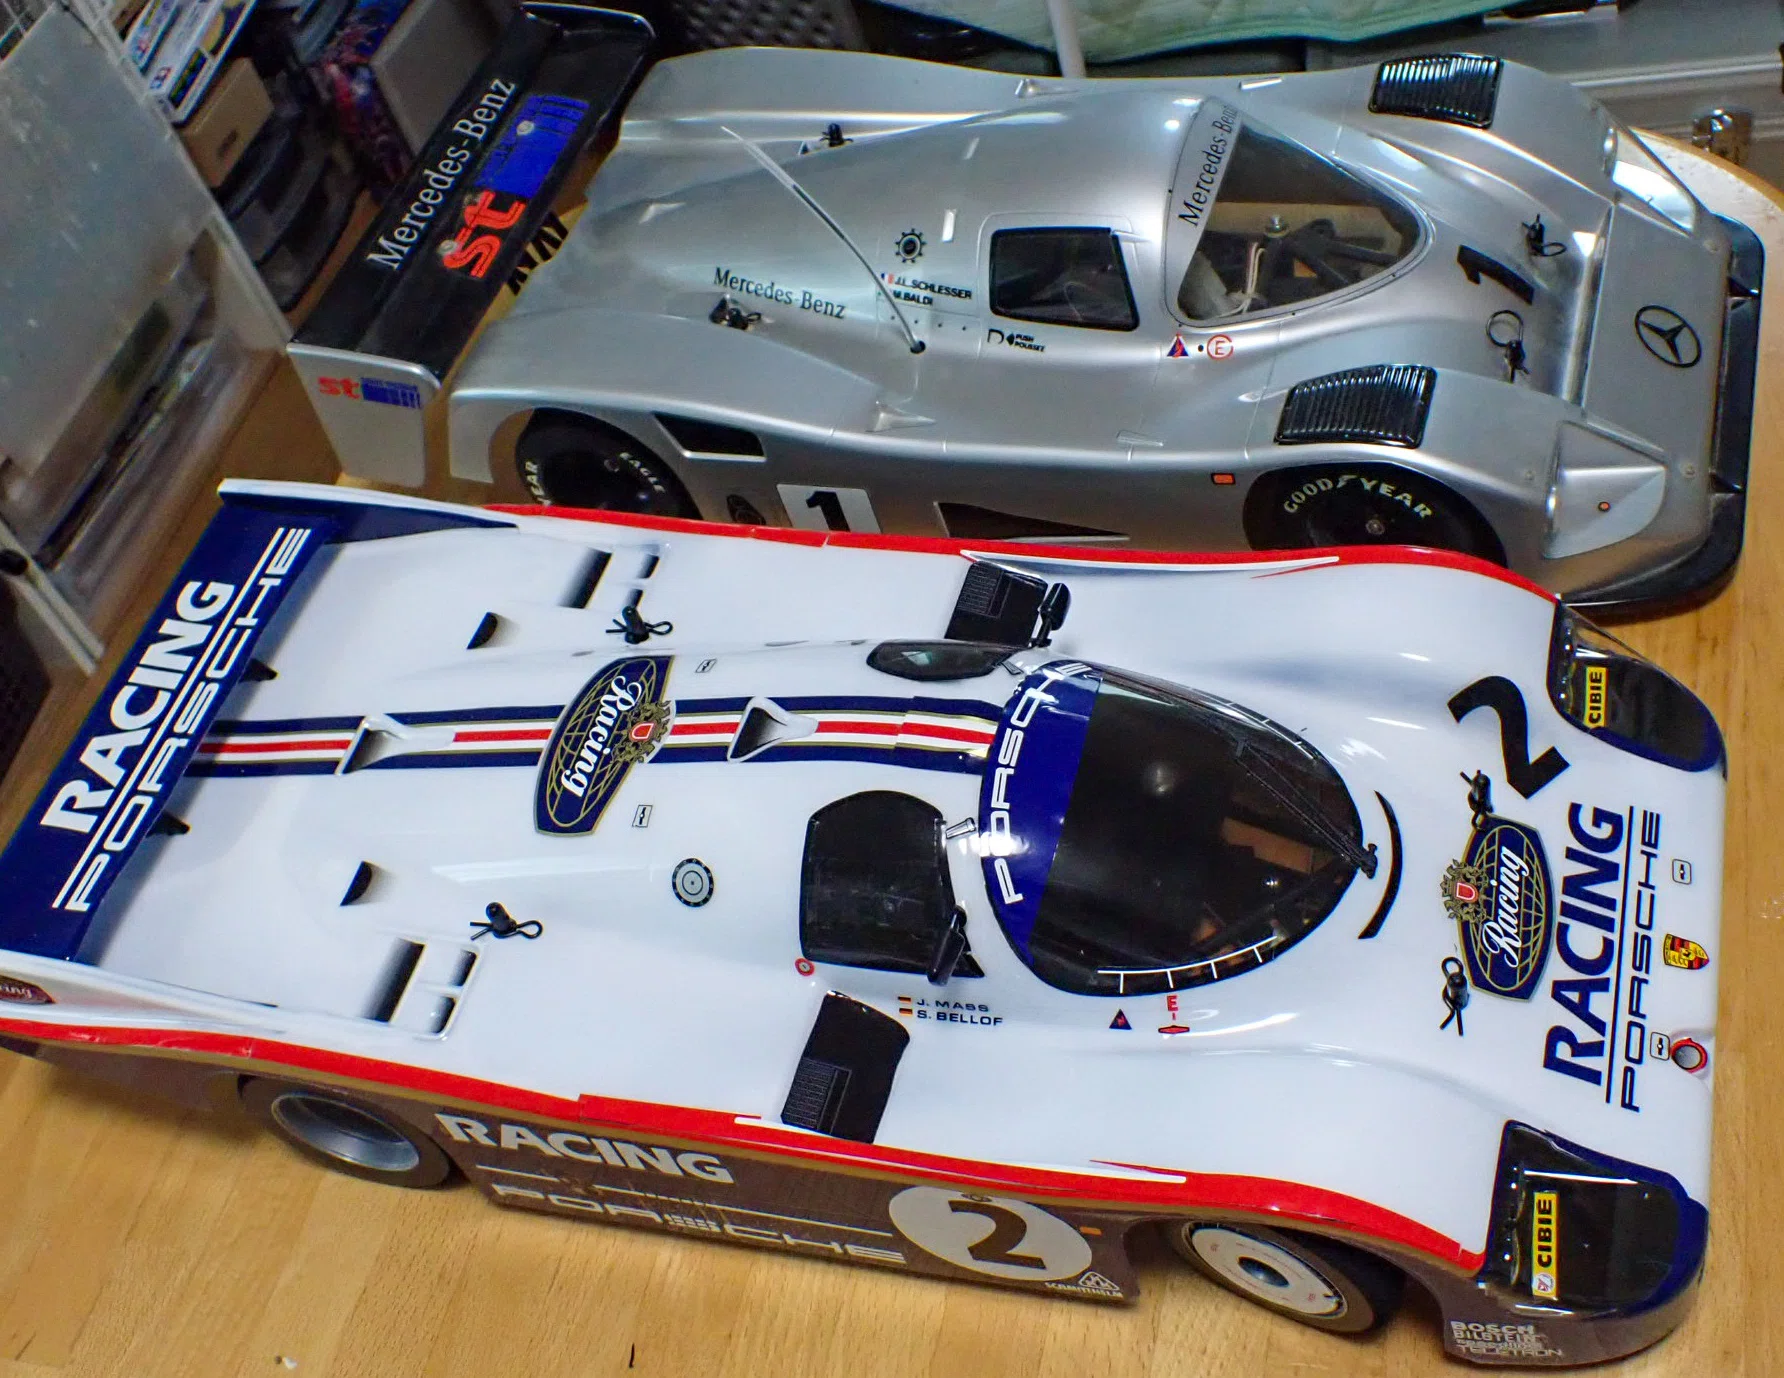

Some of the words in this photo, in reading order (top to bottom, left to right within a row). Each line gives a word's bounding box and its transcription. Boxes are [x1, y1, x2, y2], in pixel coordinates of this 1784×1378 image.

[366, 78, 516, 270] Mercedes-Benz
[1457, 245, 1534, 304] 1
[806, 490, 850, 532] 1
[40, 580, 235, 833] RACING
[64, 528, 311, 912] PORSCHE
[561, 675, 642, 798] Racing
[1447, 675, 1571, 800] 2
[1589, 672, 1603, 724] CIBIE
[990, 662, 1092, 905] PORSCHE
[1482, 845, 1530, 968] Racing
[1543, 802, 1624, 1086] RACING
[916, 998, 929, 1007] J.
[935, 1000, 989, 1013] MASS
[1620, 809, 1661, 1112] PORSCHE
[916, 1009, 932, 1020] S.
[936, 1011, 1003, 1026] BELLOF
[435, 1113, 734, 1184] RACING
[491, 1184, 907, 1265] PORSCHE
[948, 1200, 1047, 1270] 2
[1537, 1199, 1553, 1268] CIBIE
